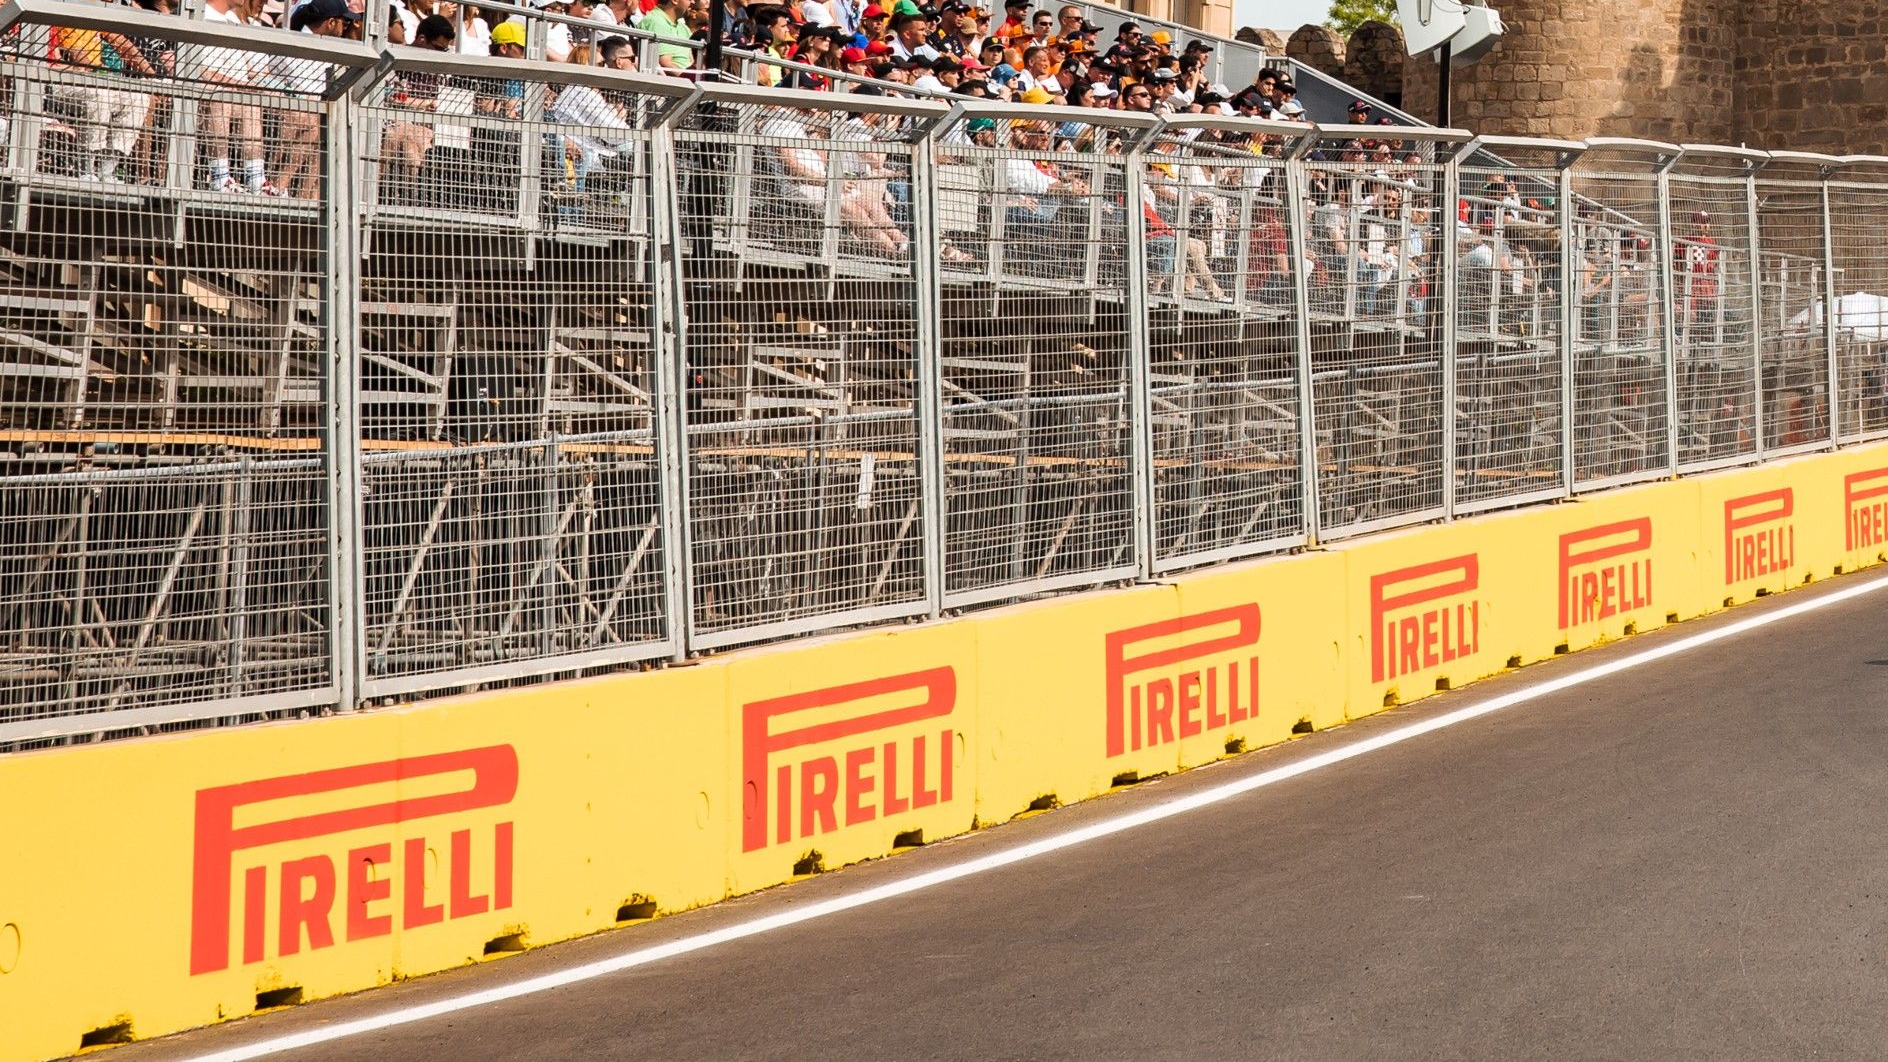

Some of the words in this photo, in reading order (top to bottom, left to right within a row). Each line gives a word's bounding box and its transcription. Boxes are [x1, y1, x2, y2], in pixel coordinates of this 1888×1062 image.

[1558, 516, 1652, 630] PIRELLI
[1724, 487, 1794, 585] PIRELLI
[1105, 602, 1261, 758] PIRELLI
[1370, 553, 1479, 683] PIRELLI
[742, 665, 957, 853] PIRELLI
[190, 743, 519, 976] PIRELLI
